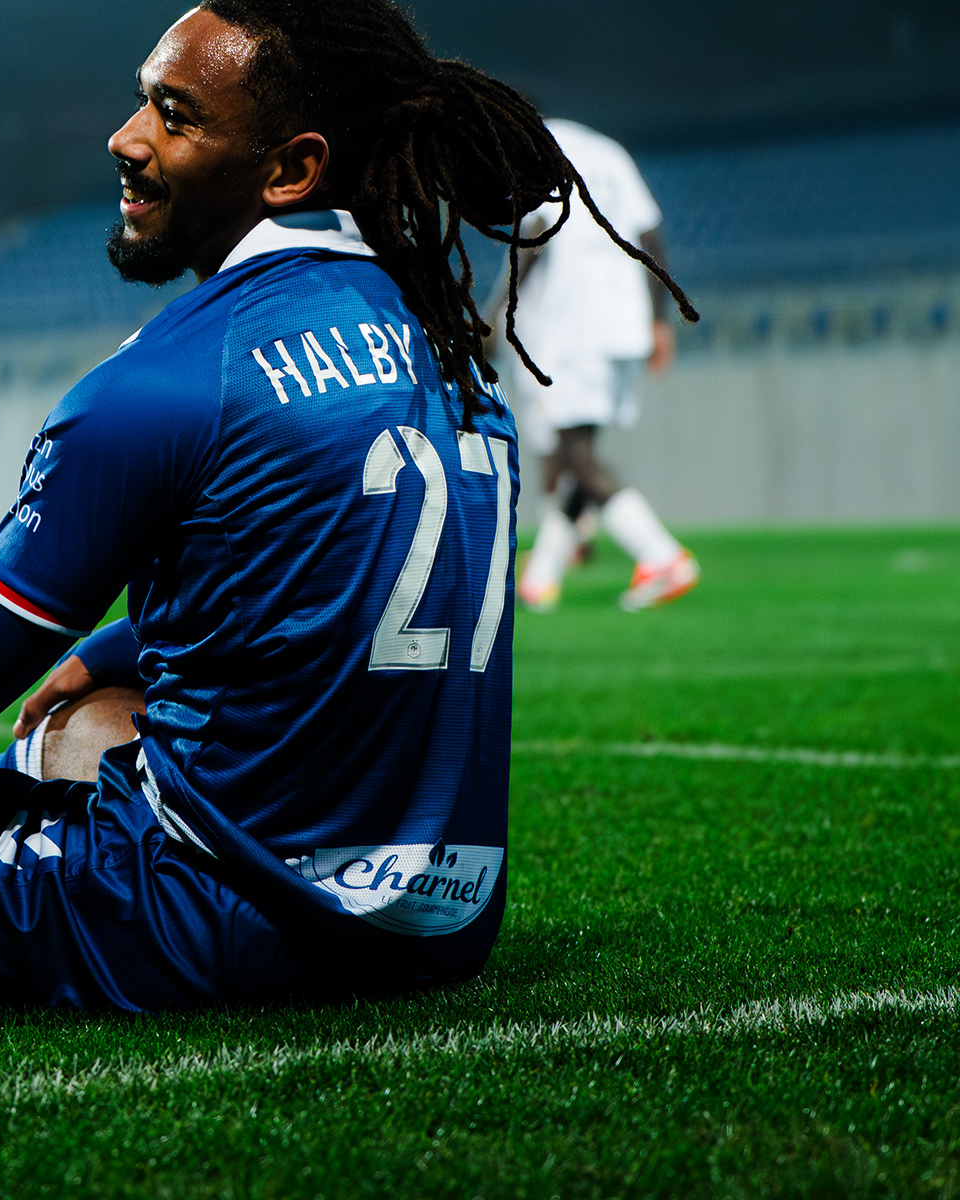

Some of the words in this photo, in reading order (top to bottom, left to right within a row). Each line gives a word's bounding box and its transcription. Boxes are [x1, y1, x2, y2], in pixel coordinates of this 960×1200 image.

[252, 323, 418, 405] HALBY
[362, 425, 512, 673] 27
[333, 853, 489, 906] Charnel
